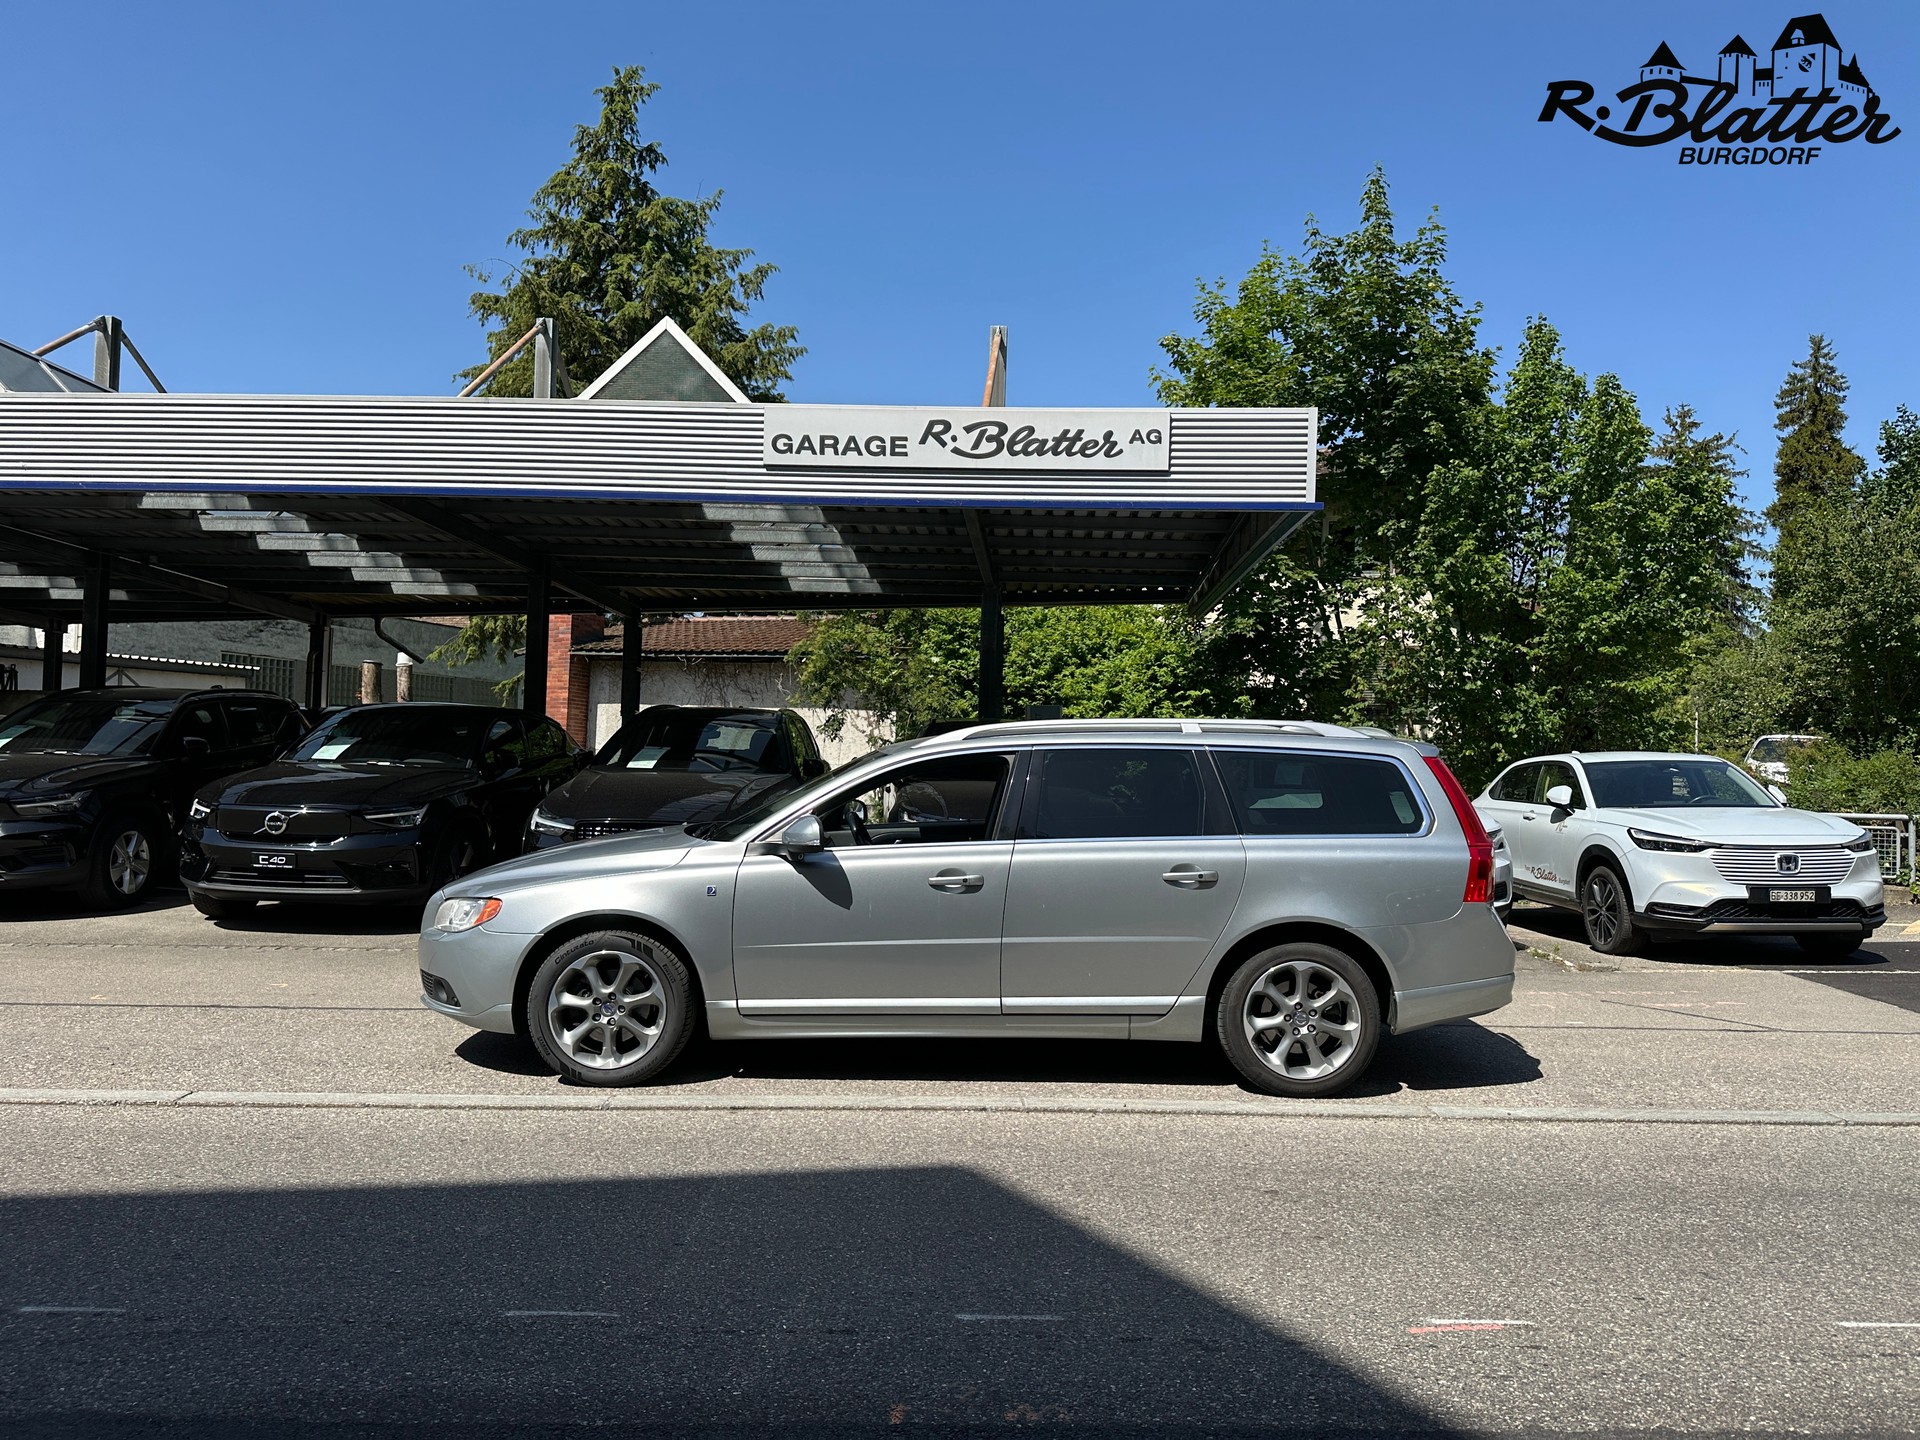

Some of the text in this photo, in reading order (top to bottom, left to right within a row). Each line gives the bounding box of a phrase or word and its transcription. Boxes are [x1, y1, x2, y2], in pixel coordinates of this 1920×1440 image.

[771, 433, 909, 457] GARAGE
[1128, 428, 1162, 445] AG
[259, 855, 286, 864] C40
[554, 940, 595, 965] Cinturato
